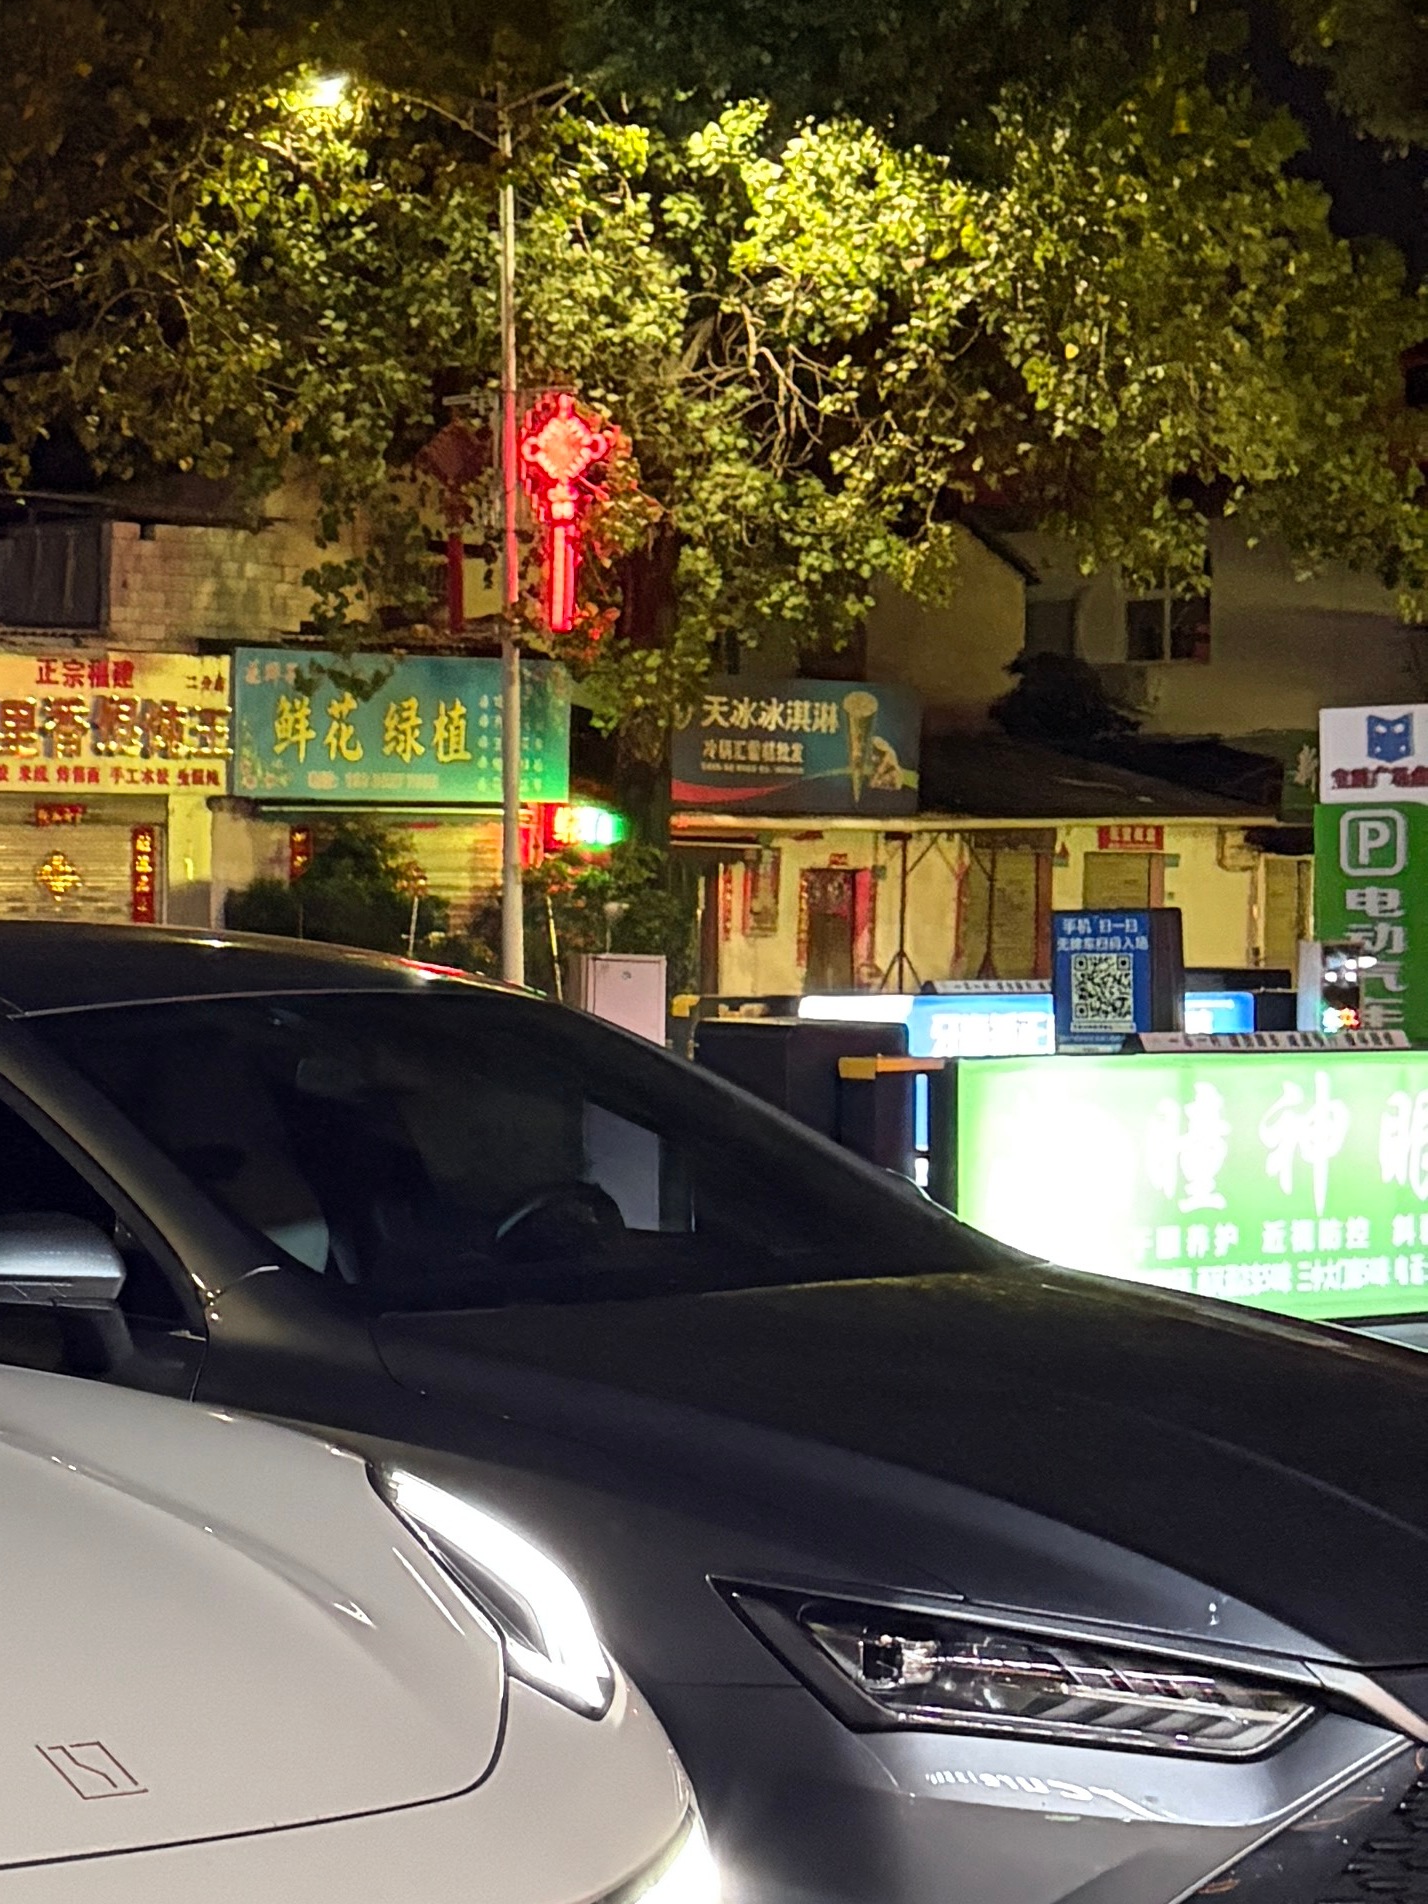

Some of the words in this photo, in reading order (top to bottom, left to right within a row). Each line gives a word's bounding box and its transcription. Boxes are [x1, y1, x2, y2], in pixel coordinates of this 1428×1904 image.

[35, 658, 135, 689] 正宗福建
[273, 691, 364, 763] 鲜花
[381, 696, 472, 764] 绿植
[1358, 820, 1392, 866] P
